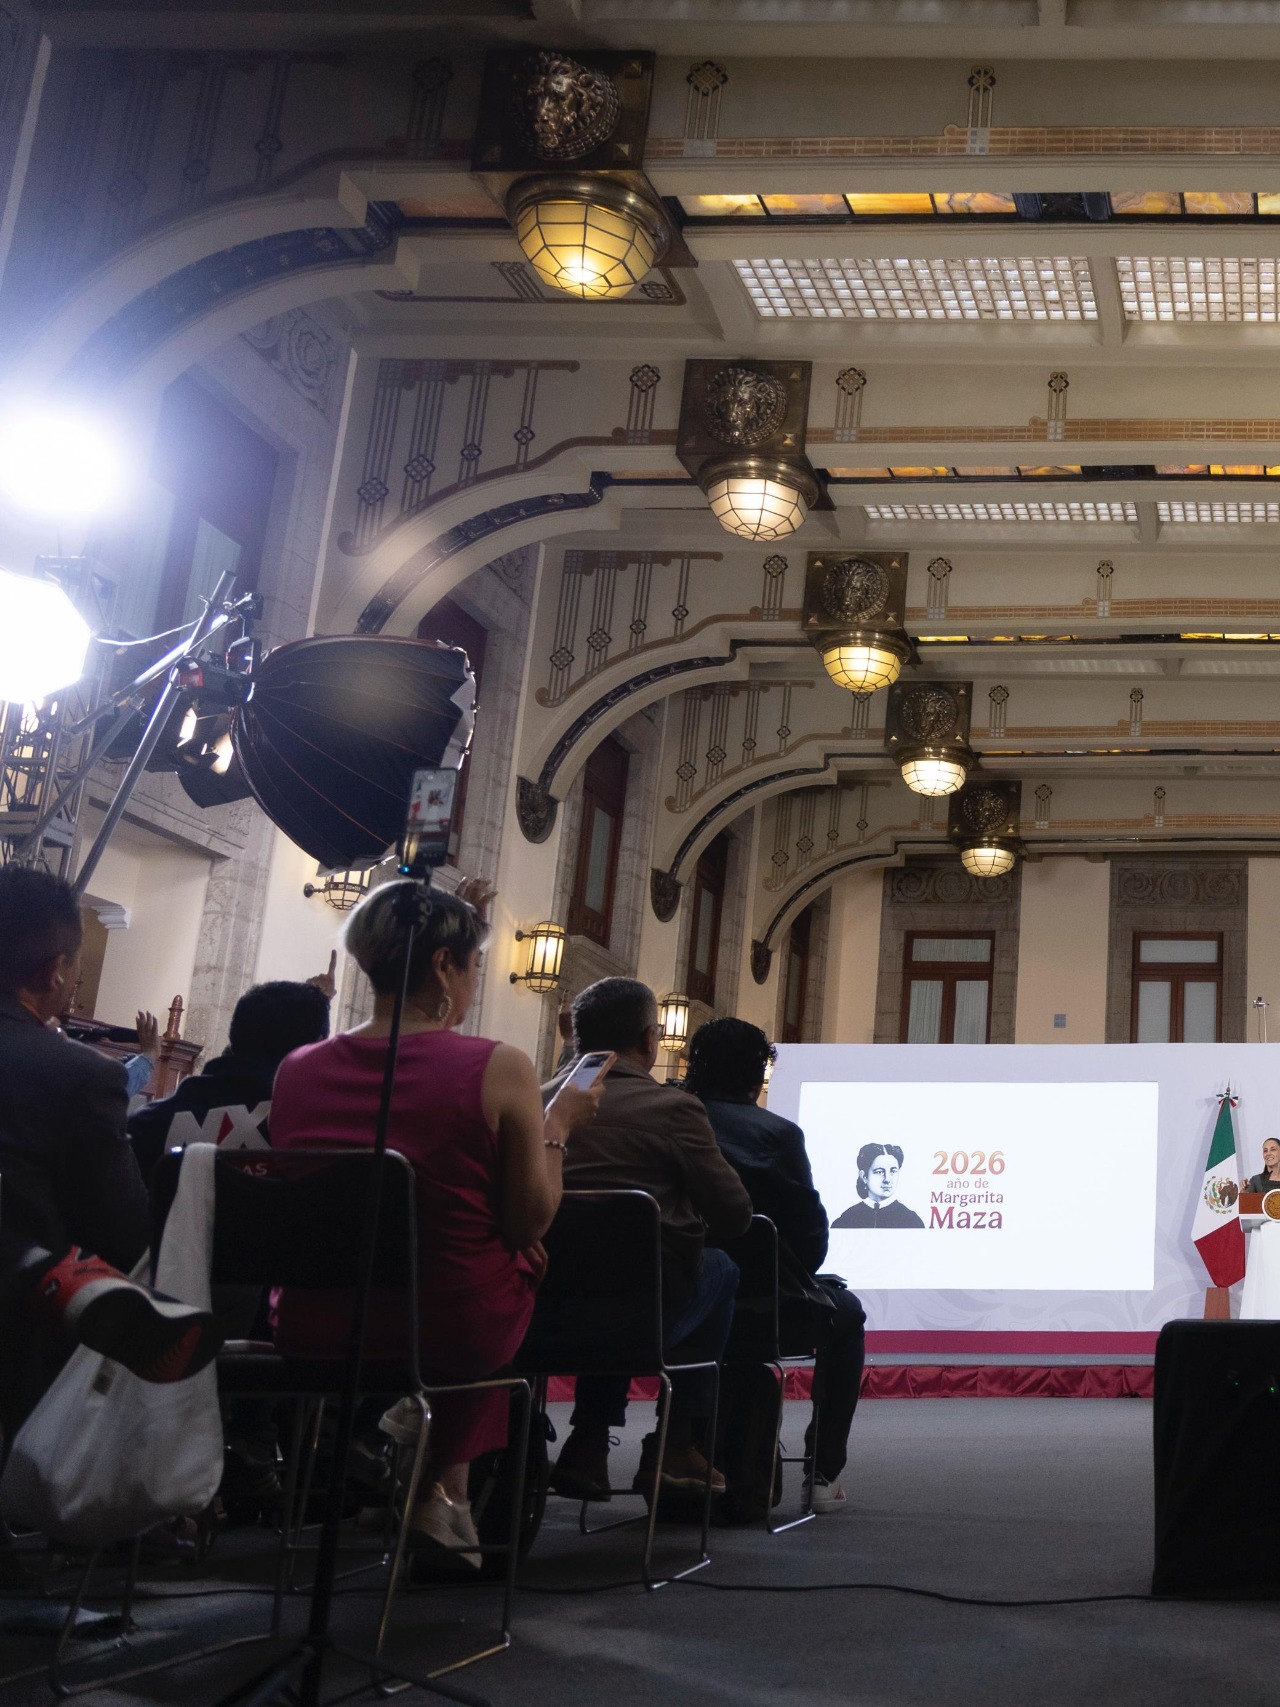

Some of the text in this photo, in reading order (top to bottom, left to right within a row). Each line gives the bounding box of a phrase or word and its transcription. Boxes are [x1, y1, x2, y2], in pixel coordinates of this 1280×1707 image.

[932, 1150, 1005, 1175] 2026
[946, 1177, 989, 1189] año de
[930, 1190, 1004, 1207] Margarita
[928, 1205, 1003, 1229] Maza
